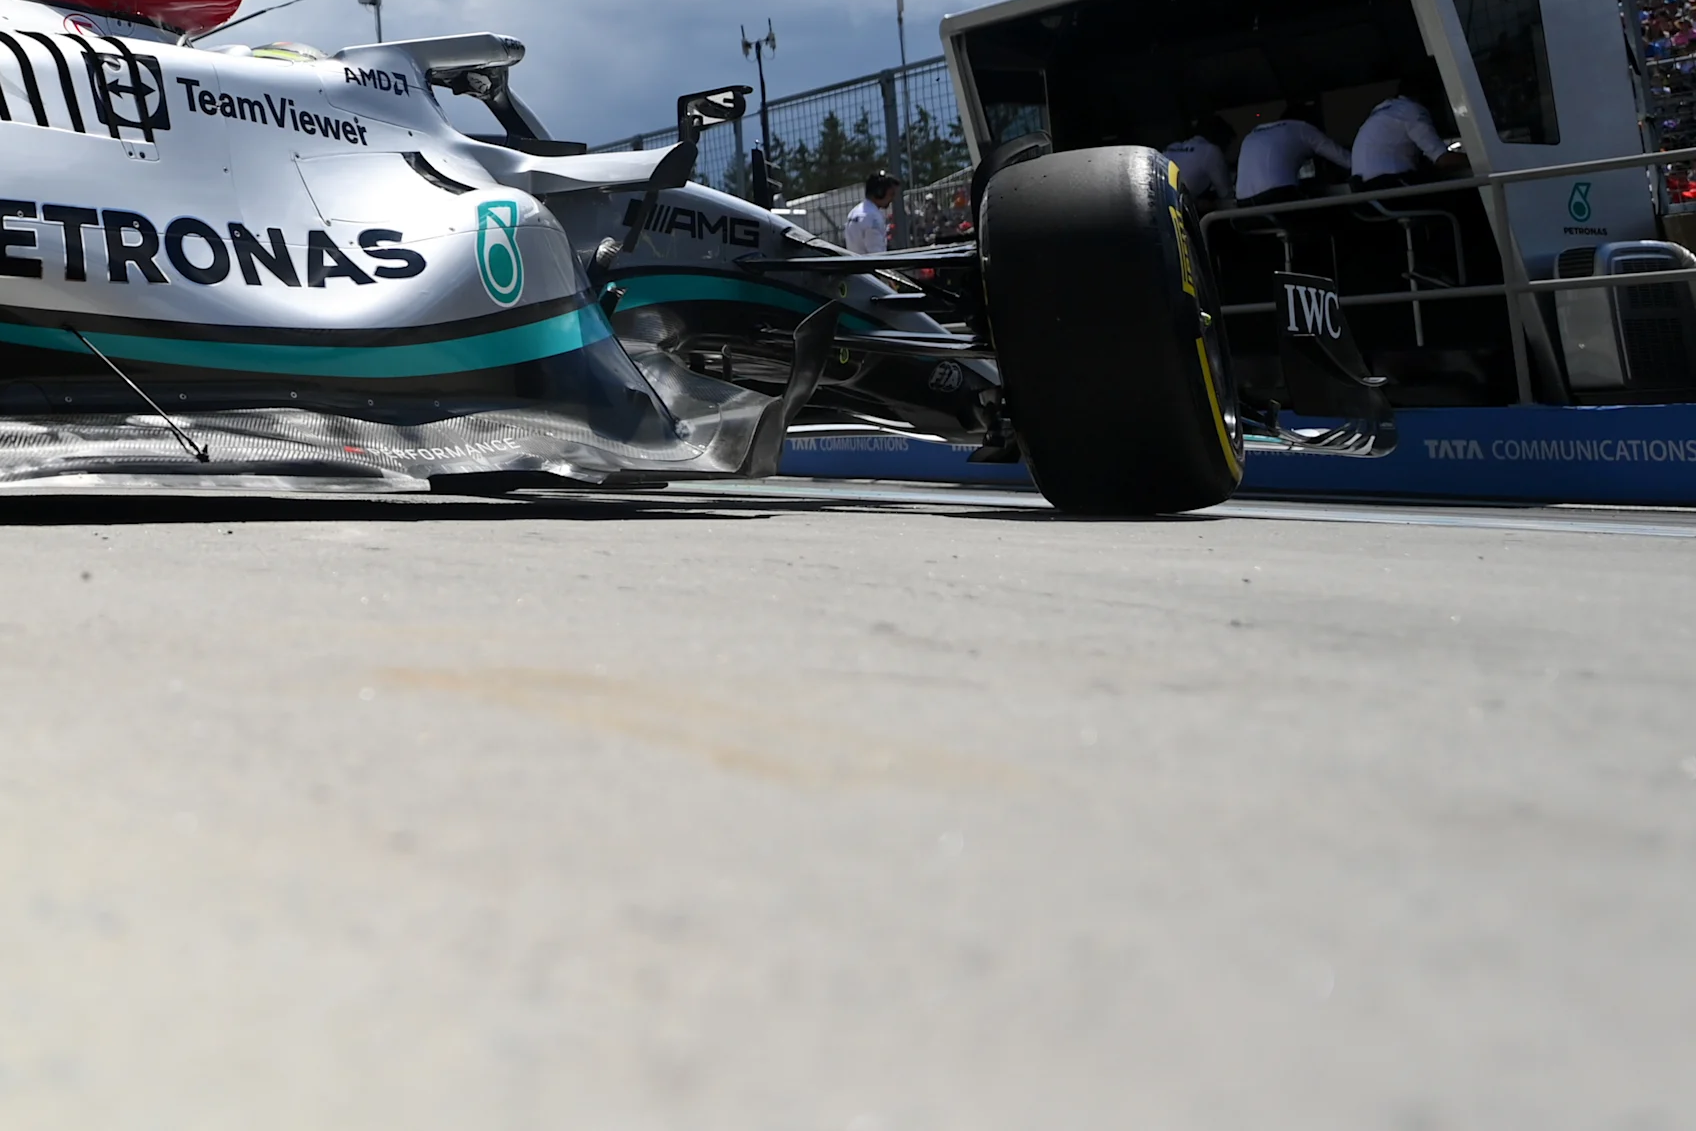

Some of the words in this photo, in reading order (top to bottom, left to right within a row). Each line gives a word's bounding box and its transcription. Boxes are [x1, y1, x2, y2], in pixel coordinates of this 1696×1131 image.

[344, 67, 392, 92] AMD
[177, 77, 369, 147] TeamViewer
[664, 206, 760, 248] AMG
[1563, 226, 1608, 236] PETRONAS
[1284, 284, 1341, 339] IWC
[367, 437, 521, 461] PERFORMANCE
[790, 438, 817, 451] TATA
[819, 437, 909, 452] COMMUNICATIONS
[1423, 439, 1484, 460] TATA
[1491, 439, 1696, 462] COMMUNICATIONS
